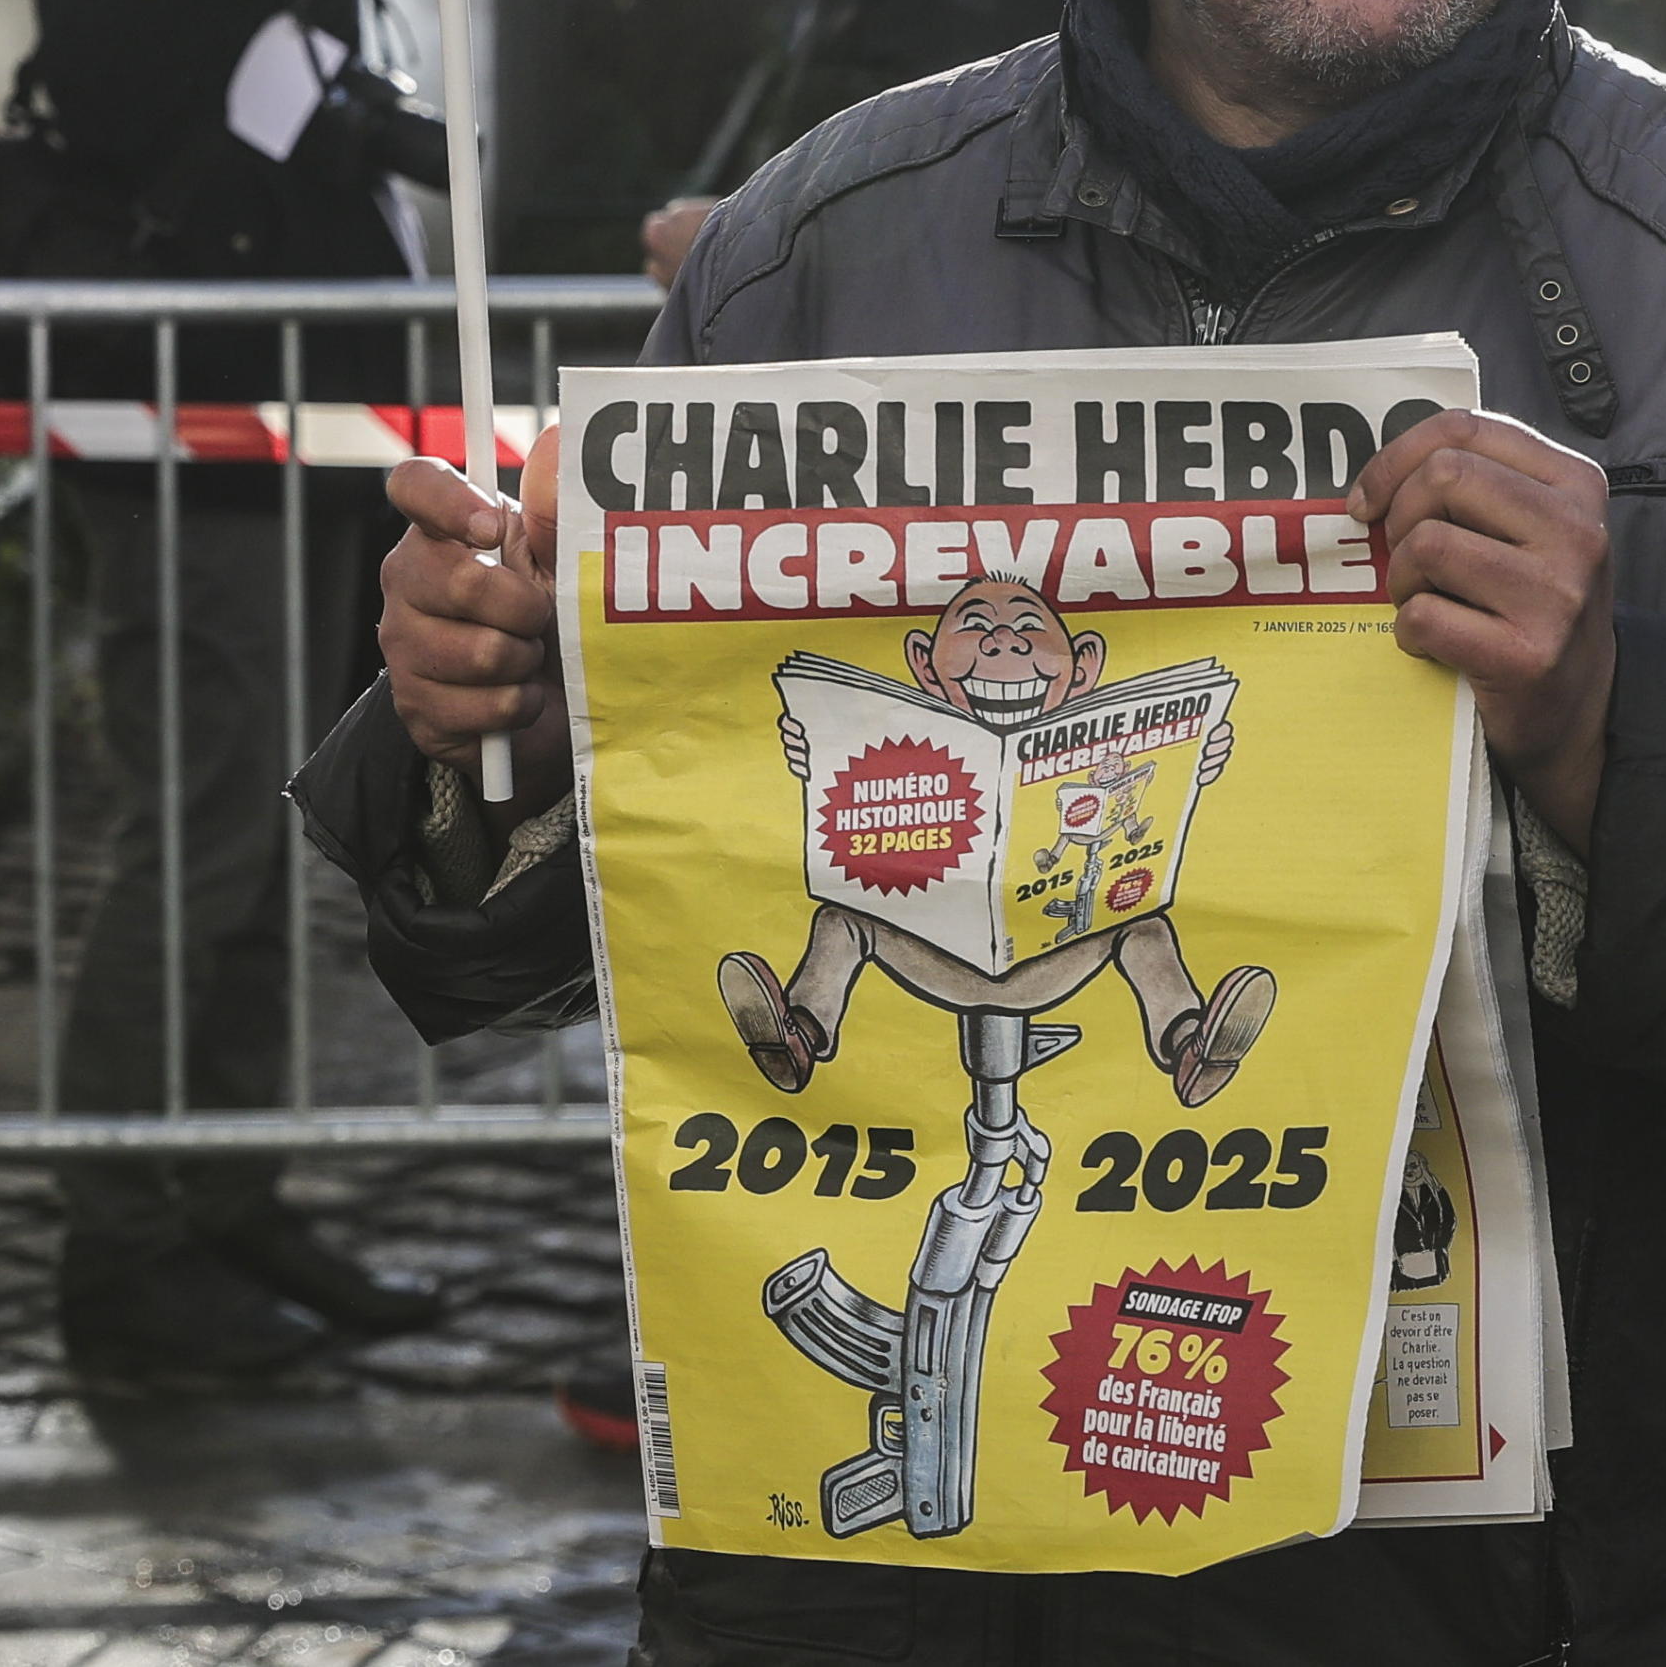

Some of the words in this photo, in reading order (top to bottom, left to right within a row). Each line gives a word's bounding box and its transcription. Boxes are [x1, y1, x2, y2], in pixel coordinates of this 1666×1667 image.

[580, 400, 1035, 514] CHARLIE
[613, 513, 1376, 613] INCREVABLE
[1253, 621, 1260, 632] 7
[1263, 621, 1314, 633] JANVIER
[1317, 621, 1346, 633] 2025
[1358, 622, 1373, 633] N°
[1376, 622, 1395, 633] 169
[1017, 712, 1126, 762] CHARLIE
[1132, 692, 1212, 734] HEBDO
[1022, 716, 1202, 784] INCREVABLE!
[853, 772, 950, 804] NUMÉRO
[836, 798, 967, 831] HISTORIQUE
[849, 834, 877, 856] 32
[881, 827, 952, 854] PAGES
[1109, 840, 1164, 870] 2025
[1016, 870, 1074, 902] 2015
[669, 1113, 917, 1199] 2015
[1076, 1126, 1330, 1213] 2025
[1125, 1291, 1202, 1320] SONDAGE
[1202, 1302, 1243, 1325] IFOP
[1401, 1310, 1426, 1323] C'est
[1427, 1312, 1441, 1322] un
[1390, 1325, 1422, 1338] devoir
[1424, 1325, 1453, 1338] d'être
[1393, 1357, 1406, 1370] La
[1407, 1357, 1451, 1374] question
[1397, 1375, 1410, 1386] ne
[1412, 1372, 1448, 1386] devrait
[1098, 1374, 1135, 1405] des
[1137, 1380, 1222, 1421] Français
[1406, 1392, 1423, 1405] pas
[1426, 1391, 1440, 1402] se
[1083, 1407, 1132, 1436] pour
[1134, 1411, 1152, 1441] la
[1158, 1414, 1227, 1453] liberté
[1408, 1408, 1440, 1423] poser.
[1082, 1436, 1108, 1465] de
[1111, 1444, 1221, 1484] caricaturer
